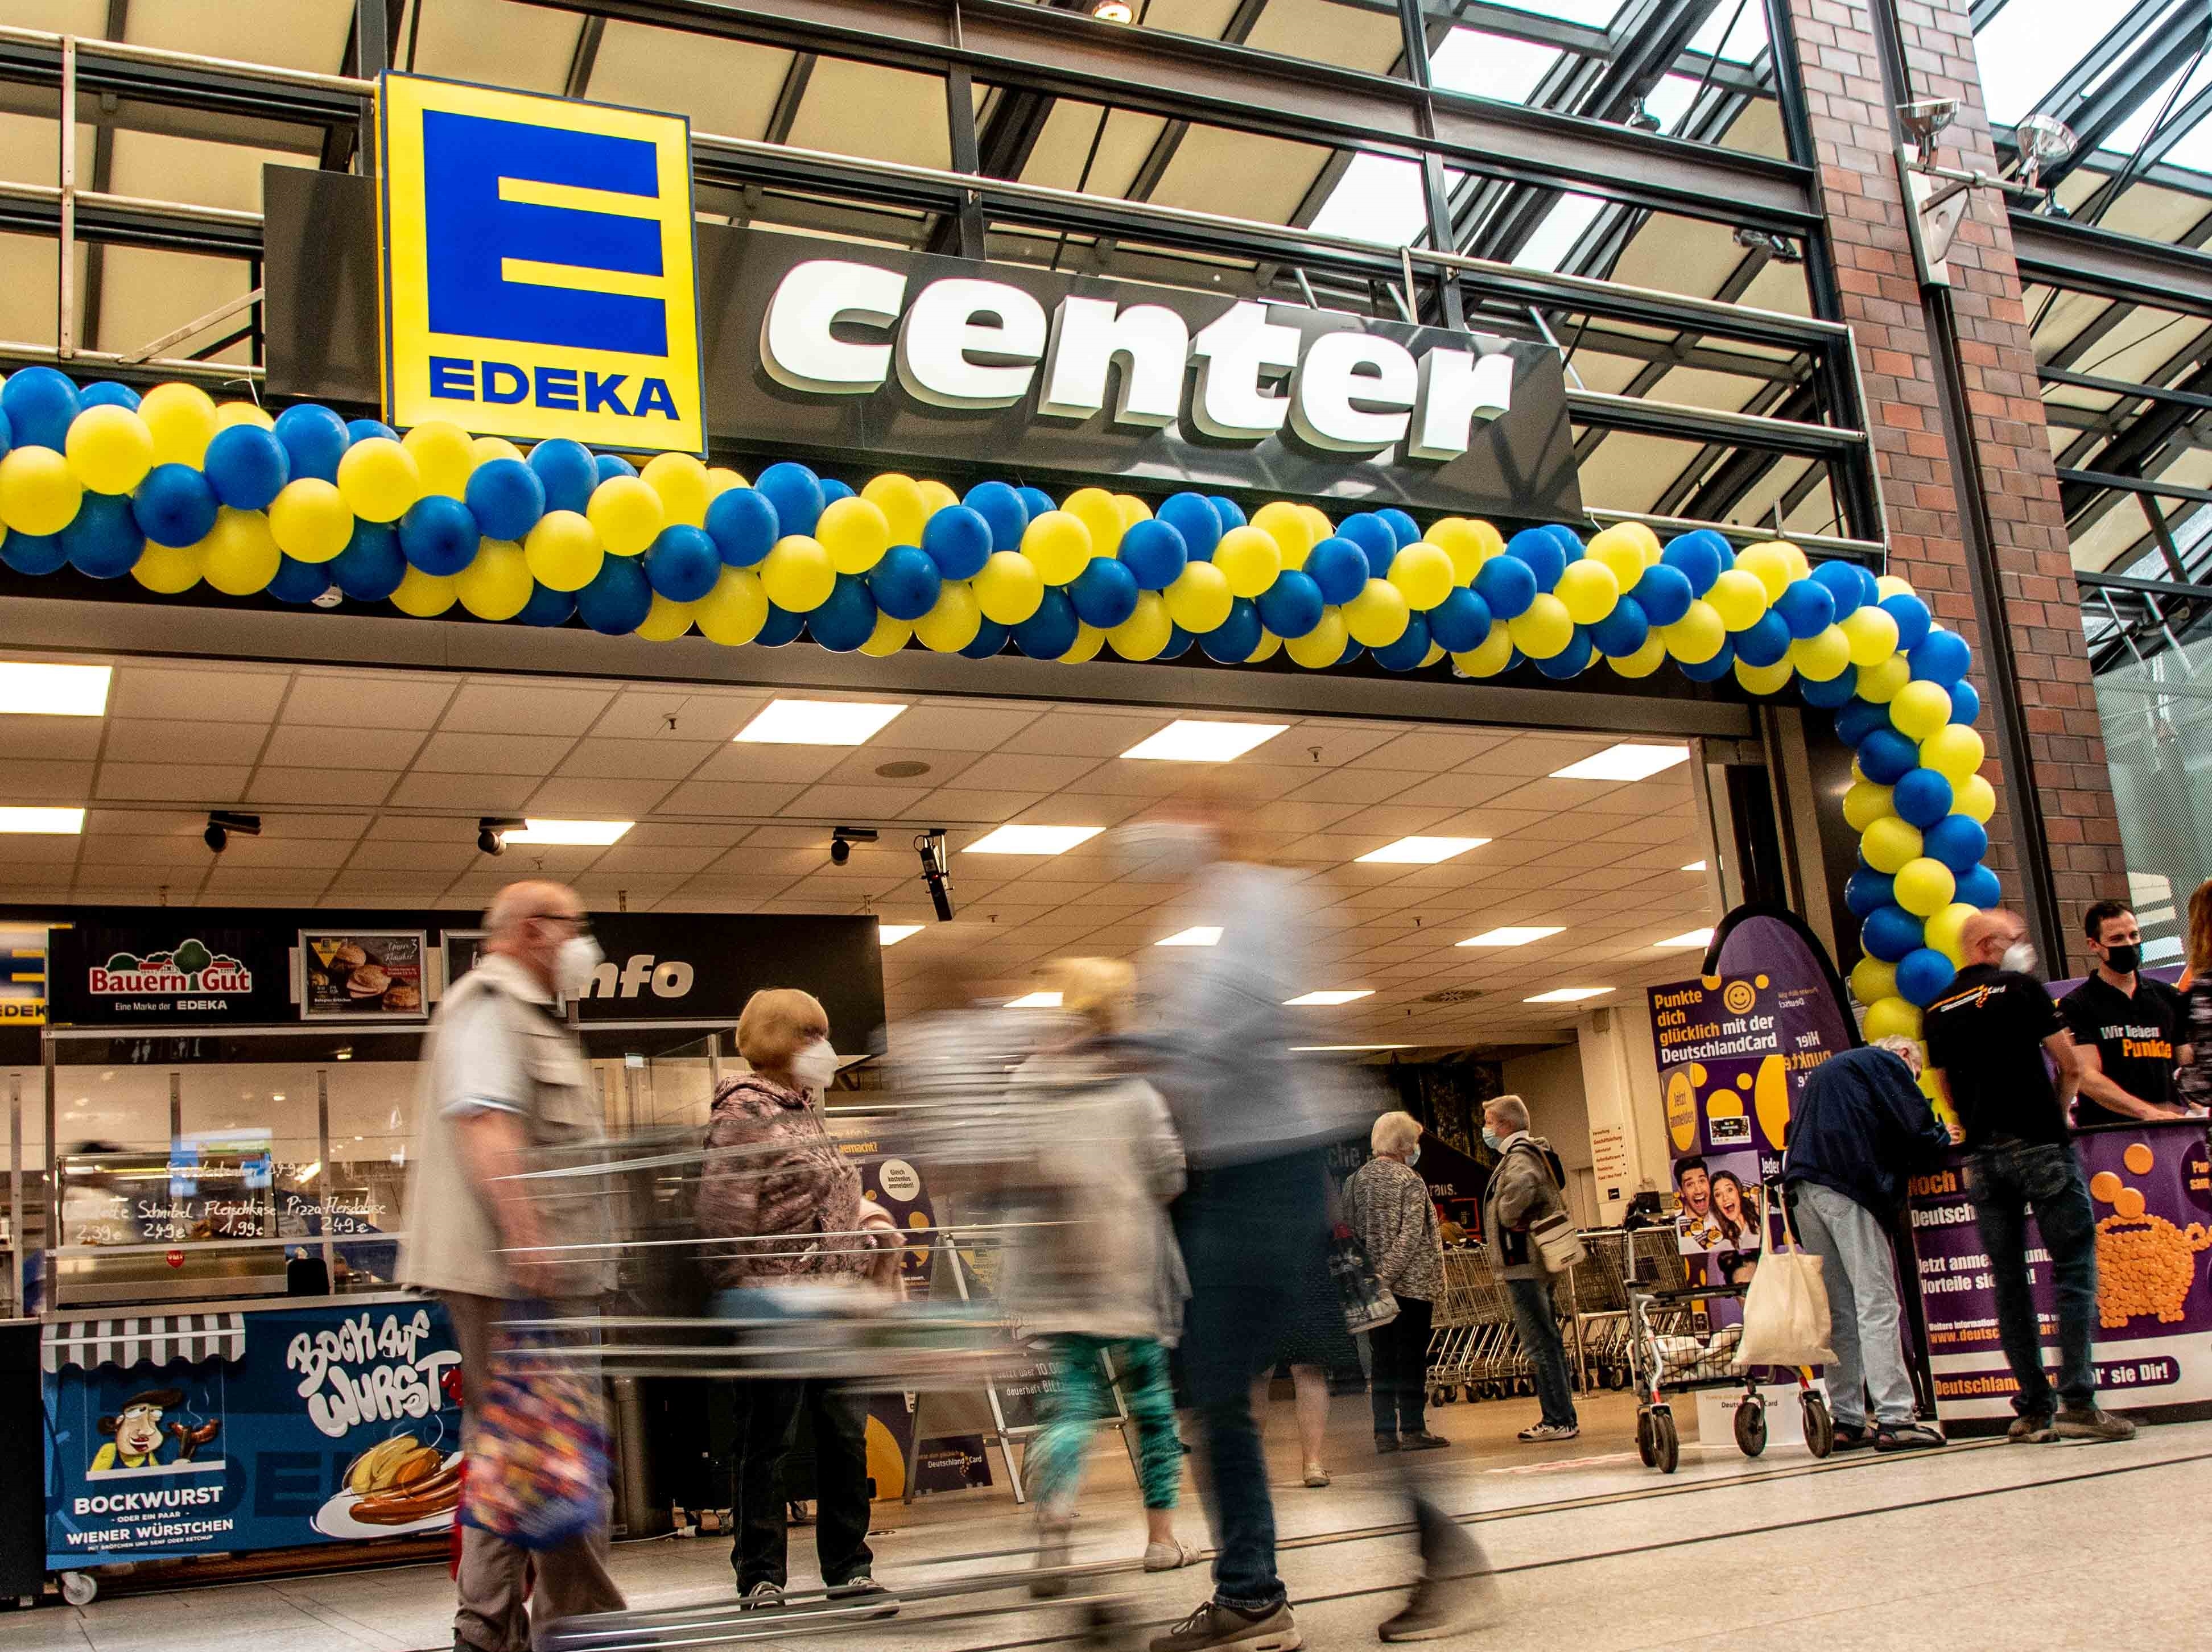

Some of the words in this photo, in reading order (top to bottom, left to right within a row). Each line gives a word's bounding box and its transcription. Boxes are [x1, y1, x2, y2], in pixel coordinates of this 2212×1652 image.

[762, 259, 1514, 461] center
[428, 356, 680, 421] EDEKA
[91, 969, 187, 992] Bauern
[202, 968, 250, 992] Gut
[579, 954, 694, 998] nfo
[115, 1002, 131, 1011] Eine
[133, 1002, 157, 1011] Marke
[158, 1002, 171, 1010] der
[176, 1000, 228, 1010] EDEKA
[1654, 990, 1703, 1009] Punkte
[0, 1004, 46, 1017] DEK
[1657, 1010, 1686, 1027] dich
[1659, 1022, 1721, 1047] glücklich
[1723, 1018, 1747, 1035] mit
[1749, 1015, 1774, 1031] der
[2099, 1025, 2124, 1039] Wir
[1661, 1032, 1778, 1064] DeutschlandCard
[2122, 1038, 2172, 1059] Punkte
[1918, 1256, 1946, 1274] Jetzt
[1949, 1253, 1993, 1271] anme
[1920, 1274, 1972, 1294] Vorteile
[1954, 1318, 1999, 1329] Information
[286, 1312, 377, 1398] BOCK
[2110, 1366, 2137, 1384] sie
[2139, 1362, 2169, 1381] Dir!
[307, 1350, 463, 1438] WURST
[928, 1457, 965, 1469] Deutschland
[969, 1455, 983, 1464] Card
[74, 1485, 224, 1515] BOCKWURST
[117, 1514, 140, 1523] ODER
[67, 1528, 131, 1546] WIENER
[136, 1518, 234, 1539] WÜRSTCHEN
[185, 1534, 214, 1543] KETCHUP
